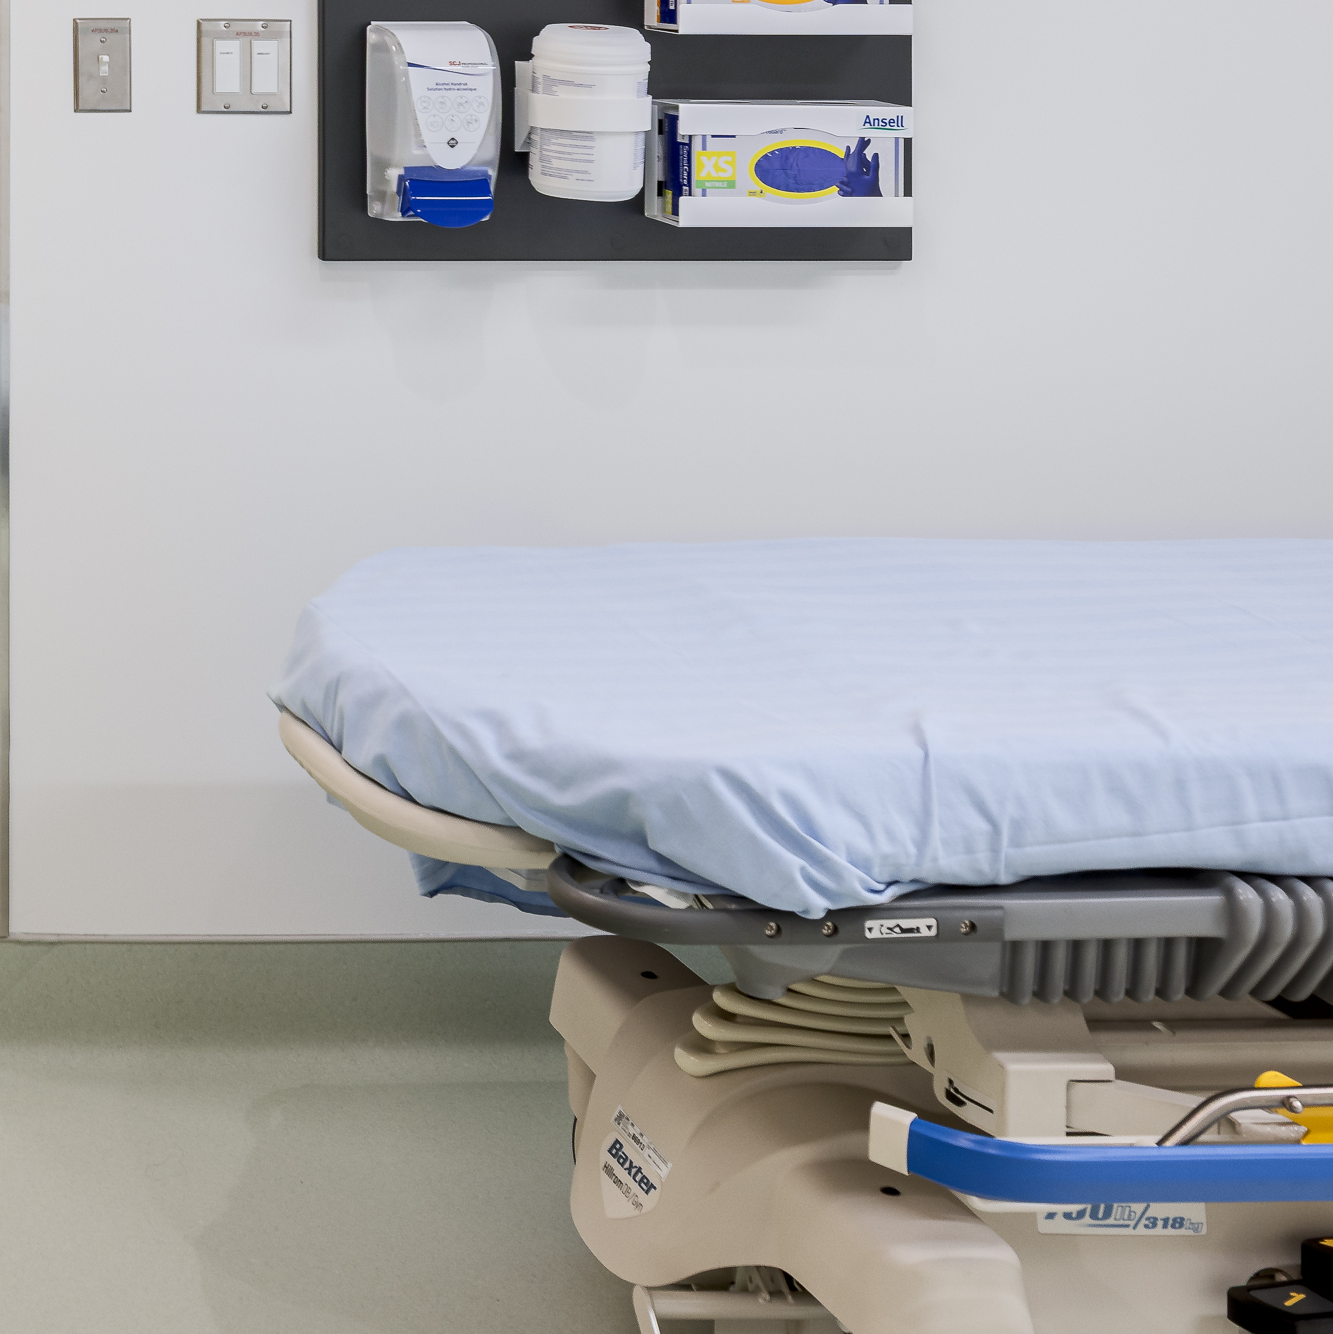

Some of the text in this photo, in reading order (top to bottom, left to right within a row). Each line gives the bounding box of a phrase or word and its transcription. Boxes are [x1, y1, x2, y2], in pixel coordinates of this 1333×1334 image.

[863, 114, 905, 127] Ansell
[699, 155, 733, 178] XS
[607, 1137, 657, 1196] Baxter
